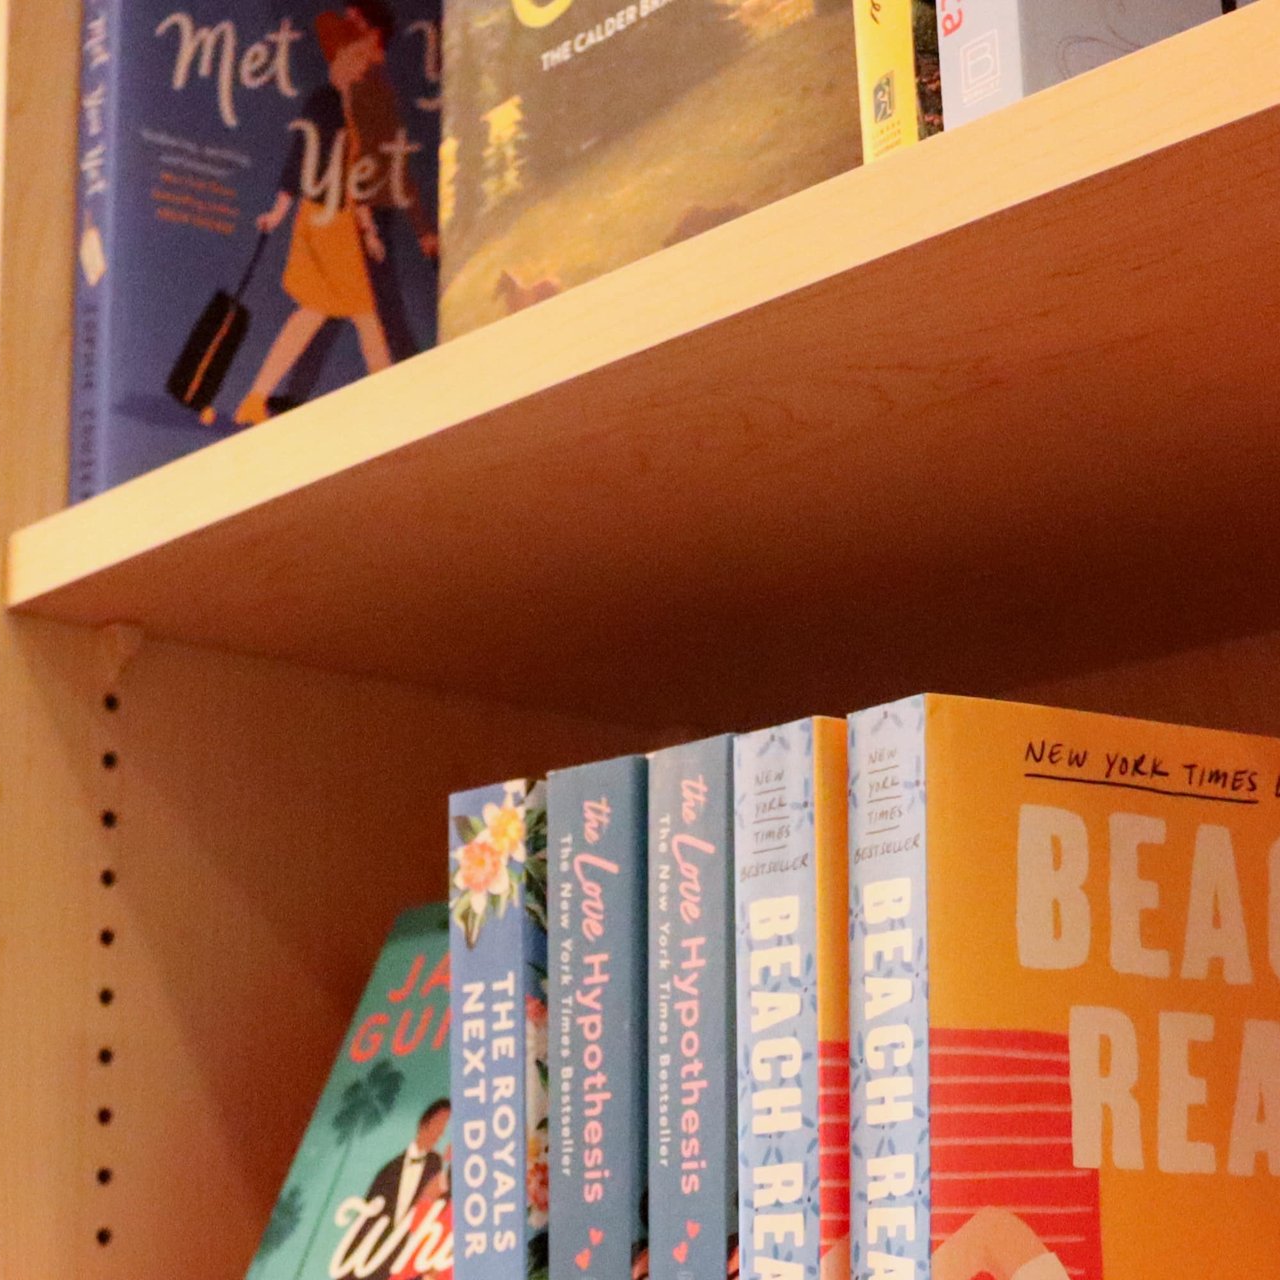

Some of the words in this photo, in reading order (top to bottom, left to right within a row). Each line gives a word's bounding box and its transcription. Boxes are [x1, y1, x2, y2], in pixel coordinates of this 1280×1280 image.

[541, 39, 573, 71] THE
[574, 5, 638, 53] CALDER
[155, 11, 303, 128] Met
[288, 118, 422, 226] Yet
[1025, 740, 1088, 769] NEW
[1106, 753, 1169, 779] YORK
[1183, 763, 1258, 792] TIMES
[582, 796, 612, 844] the
[680, 774, 710, 825] the
[867, 805, 904, 824] TIMES
[558, 832, 572, 871] The
[656, 814, 671, 854] The
[753, 825, 792, 843] TIMES
[854, 833, 921, 864] BESTSELLER
[656, 864, 671, 909] New
[740, 852, 809, 883] BESTSELLER
[558, 883, 573, 925] New
[558, 929, 572, 987] York
[657, 912, 671, 972] York
[491, 971, 516, 1061] THE
[560, 996, 572, 1055] Times
[657, 982, 671, 1045] Times
[748, 894, 803, 1136] BEACH
[863, 877, 914, 1126] BEACH
[462, 983, 487, 1104] NEXT
[673, 937, 708, 1196] Hypothesis
[575, 953, 612, 1204] Hypothesis
[561, 1063, 573, 1177] Bestseller
[658, 1053, 671, 1168] Bestseller
[463, 1119, 488, 1259] DOOR
[491, 1075, 517, 1254] ROYALS
